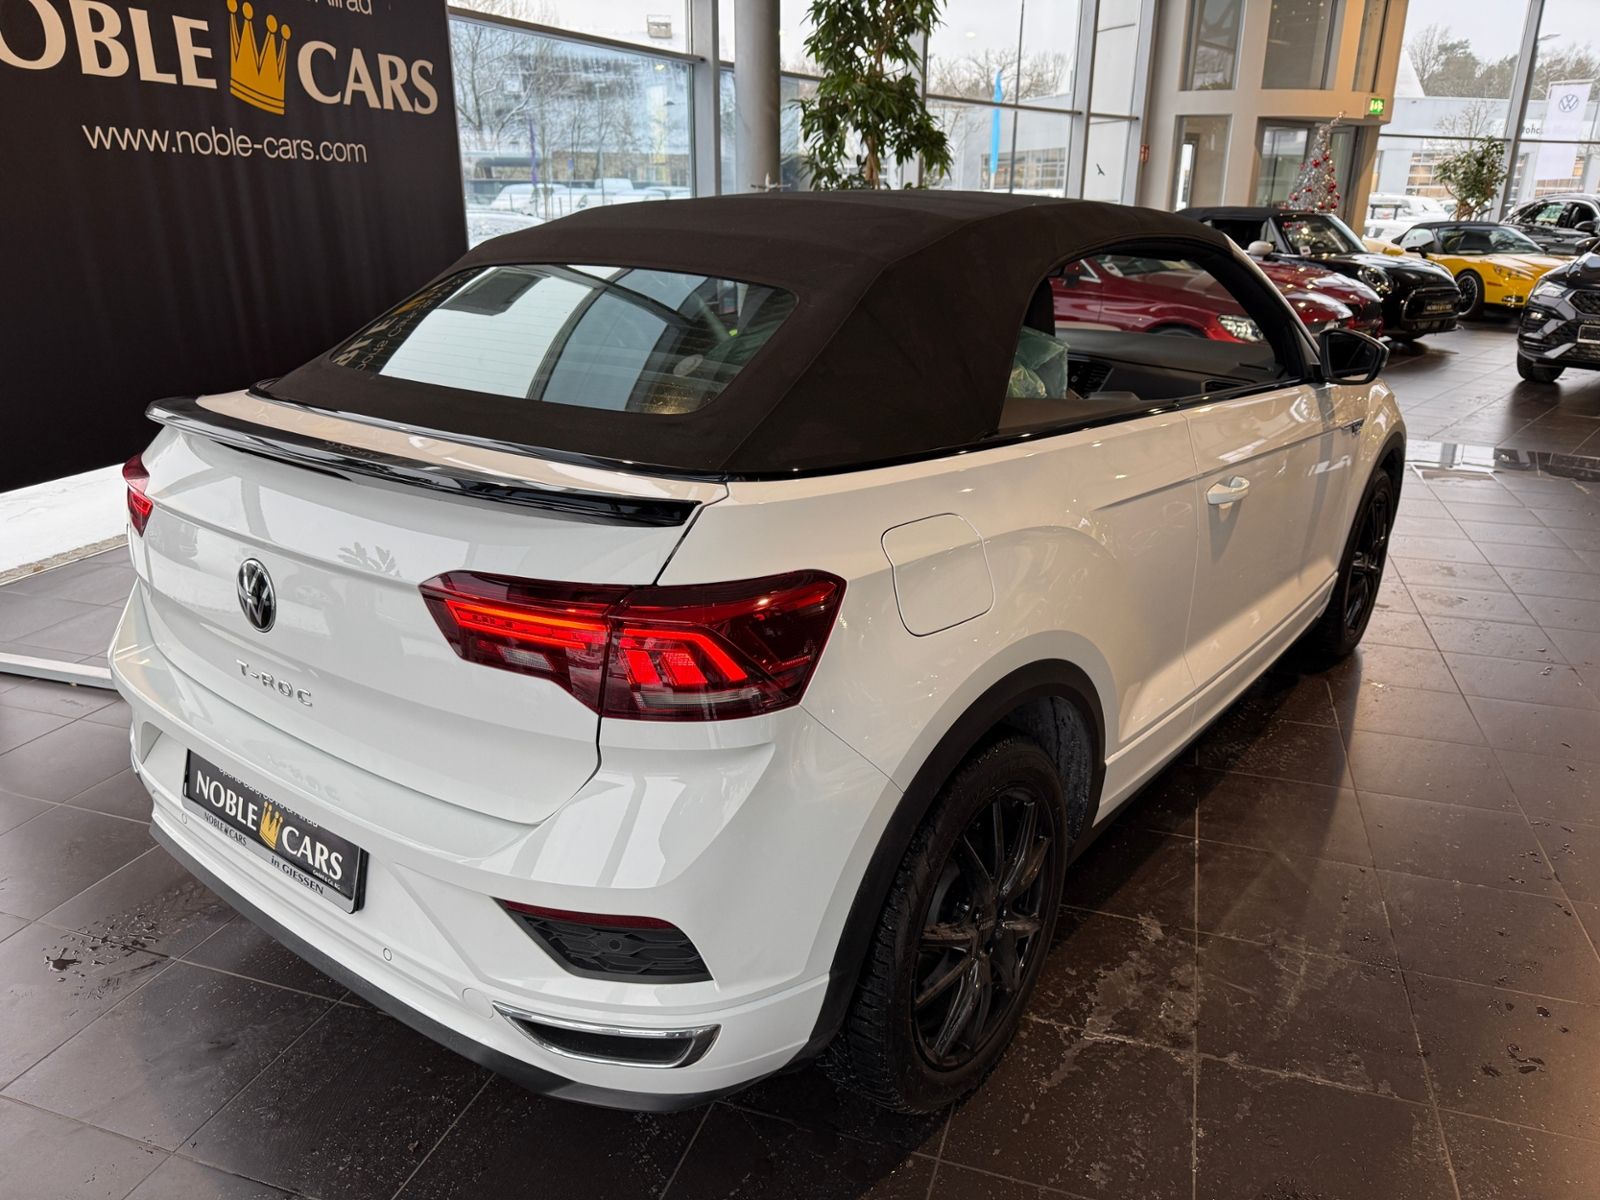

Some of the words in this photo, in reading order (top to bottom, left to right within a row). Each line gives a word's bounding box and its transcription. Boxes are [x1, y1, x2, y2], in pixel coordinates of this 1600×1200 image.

[297, 40, 438, 115] CARS
[81, 124, 368, 163] www.noble-cars.com
[236, 659, 313, 707] T-ROC
[195, 770, 258, 832] NOBLE
[281, 825, 343, 880] CARS
[203, 812, 226, 833] NOBLE
[228, 829, 247, 846] CARS
[271, 855, 280, 868] in
[282, 862, 325, 895] GIESSEN
